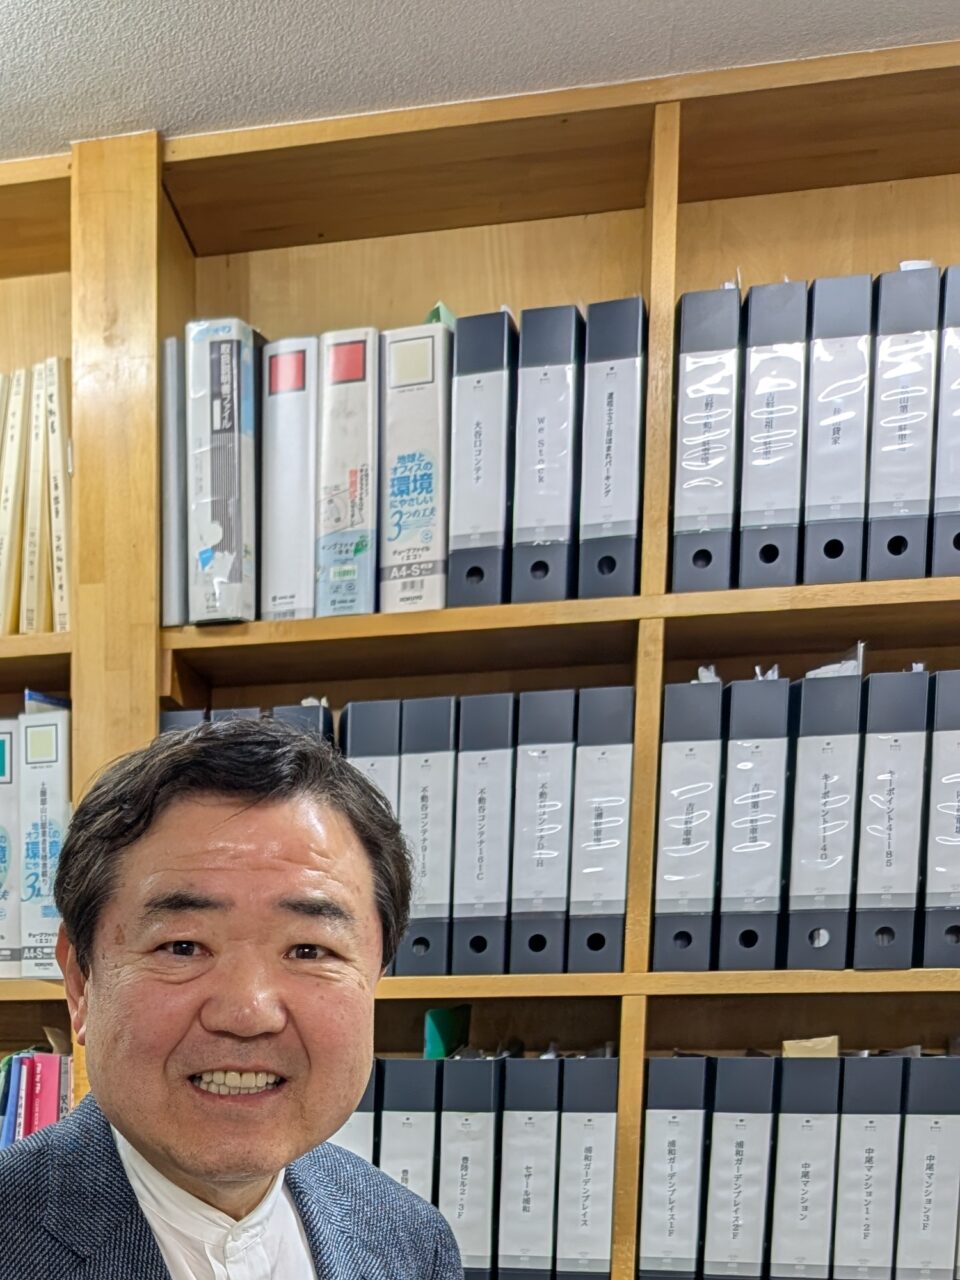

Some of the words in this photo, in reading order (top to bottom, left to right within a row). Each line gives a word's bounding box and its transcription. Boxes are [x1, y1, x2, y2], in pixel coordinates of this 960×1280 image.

[473, 420, 483, 484] 大谷口コンテナ
[390, 473, 433, 497] 環境
[390, 498, 433, 509] にやさしい
[391, 564, 420, 578] A4-S
[23, 947, 42, 959] A4-S
[799, 1162, 811, 1222] 中尾マンション
[922, 1154, 936, 1232] 中尾マンション3F
